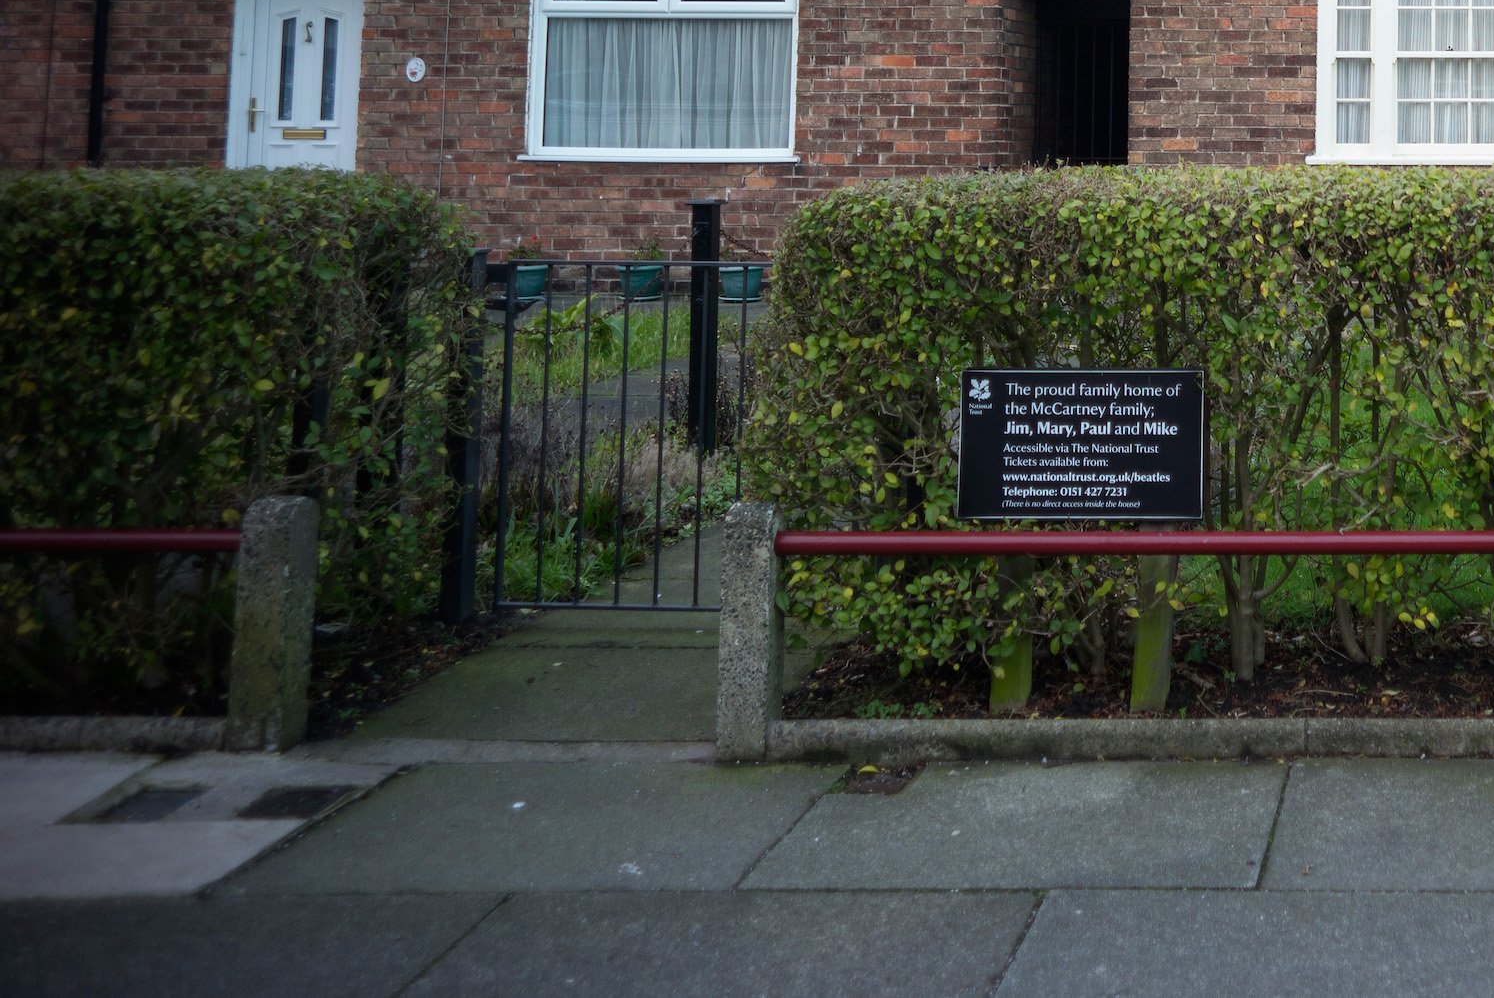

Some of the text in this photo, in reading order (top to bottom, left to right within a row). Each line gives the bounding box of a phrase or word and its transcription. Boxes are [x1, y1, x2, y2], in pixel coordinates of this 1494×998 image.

[1006, 383, 1181, 398] The proud family home of
[1005, 402, 1155, 418] the McCartney family;
[1004, 422, 1177, 437] Jim, Mary, Paul and Mike
[1003, 443, 1159, 453] Accessible via The National Trust
[1003, 457, 1108, 466] Tickets available from:
[1002, 473, 1170, 484] www.nationaltrust.org.uk/beatles
[1002, 487, 1127, 498] Telephone: 0151 427 7231
